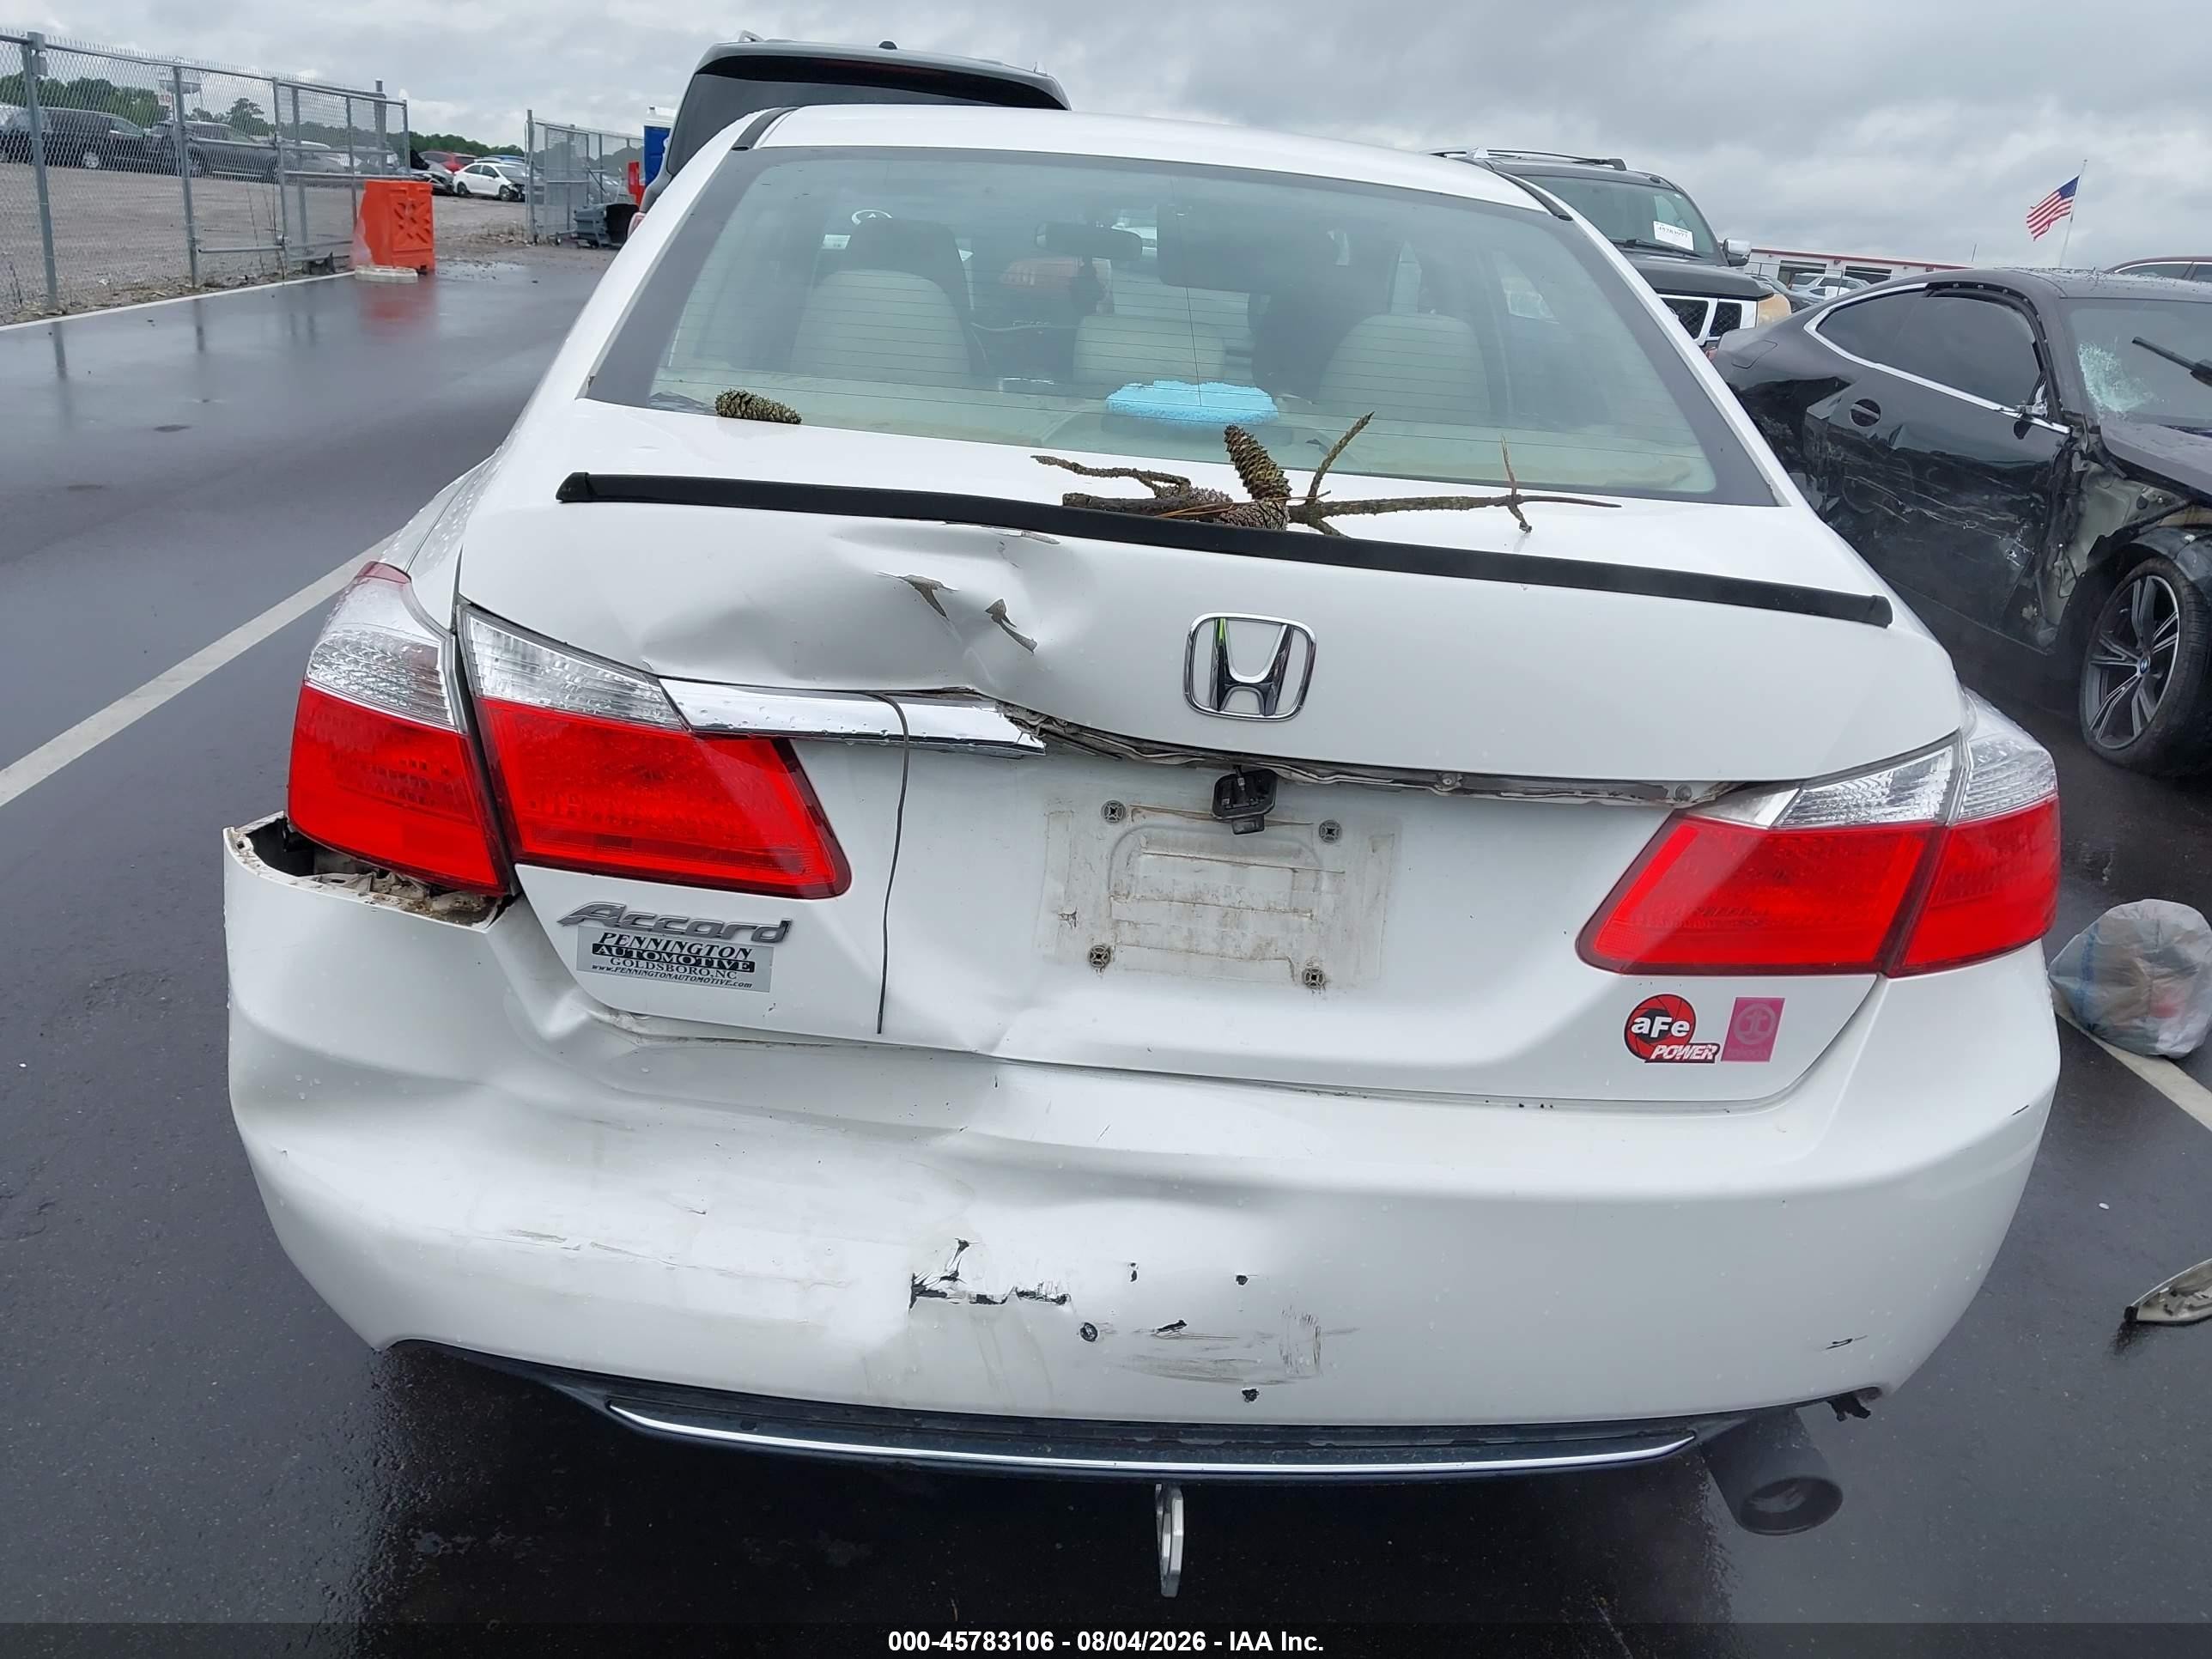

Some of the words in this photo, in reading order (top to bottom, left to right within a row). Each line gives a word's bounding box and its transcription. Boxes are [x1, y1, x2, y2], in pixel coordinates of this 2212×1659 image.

[556, 902, 792, 944] Accord
[595, 945, 753, 972] AUTOMOTIVE
[599, 932, 753, 960] PENNINGTON
[592, 964, 753, 988] www.PENNINGTONAUTOMOTIVE.com
[1632, 1016, 1690, 1038] aFe
[1650, 1044, 1717, 1060] POWER
